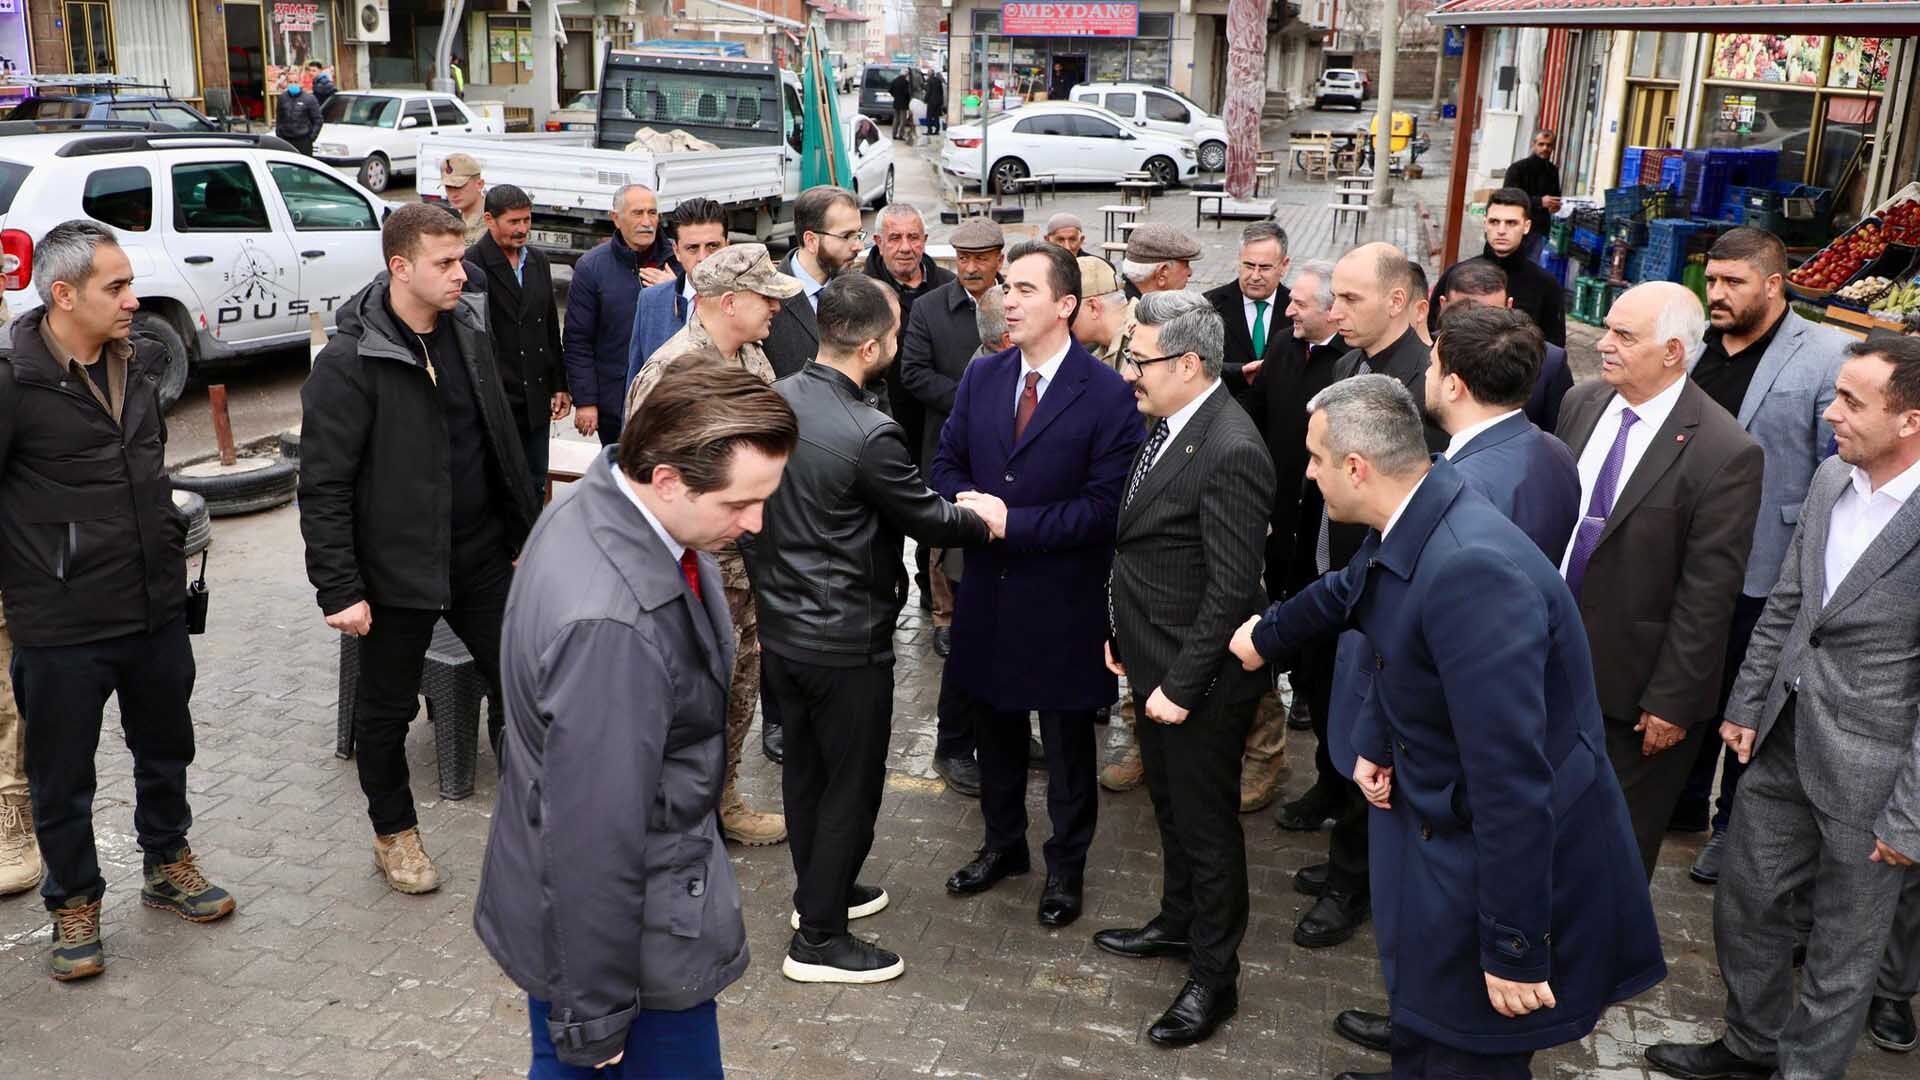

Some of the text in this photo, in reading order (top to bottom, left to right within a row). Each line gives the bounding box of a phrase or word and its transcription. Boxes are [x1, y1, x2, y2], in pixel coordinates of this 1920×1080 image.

[1019, 3, 1122, 18] MEYDAN
[537, 232, 547, 241] AT
[554, 233, 569, 243] 395
